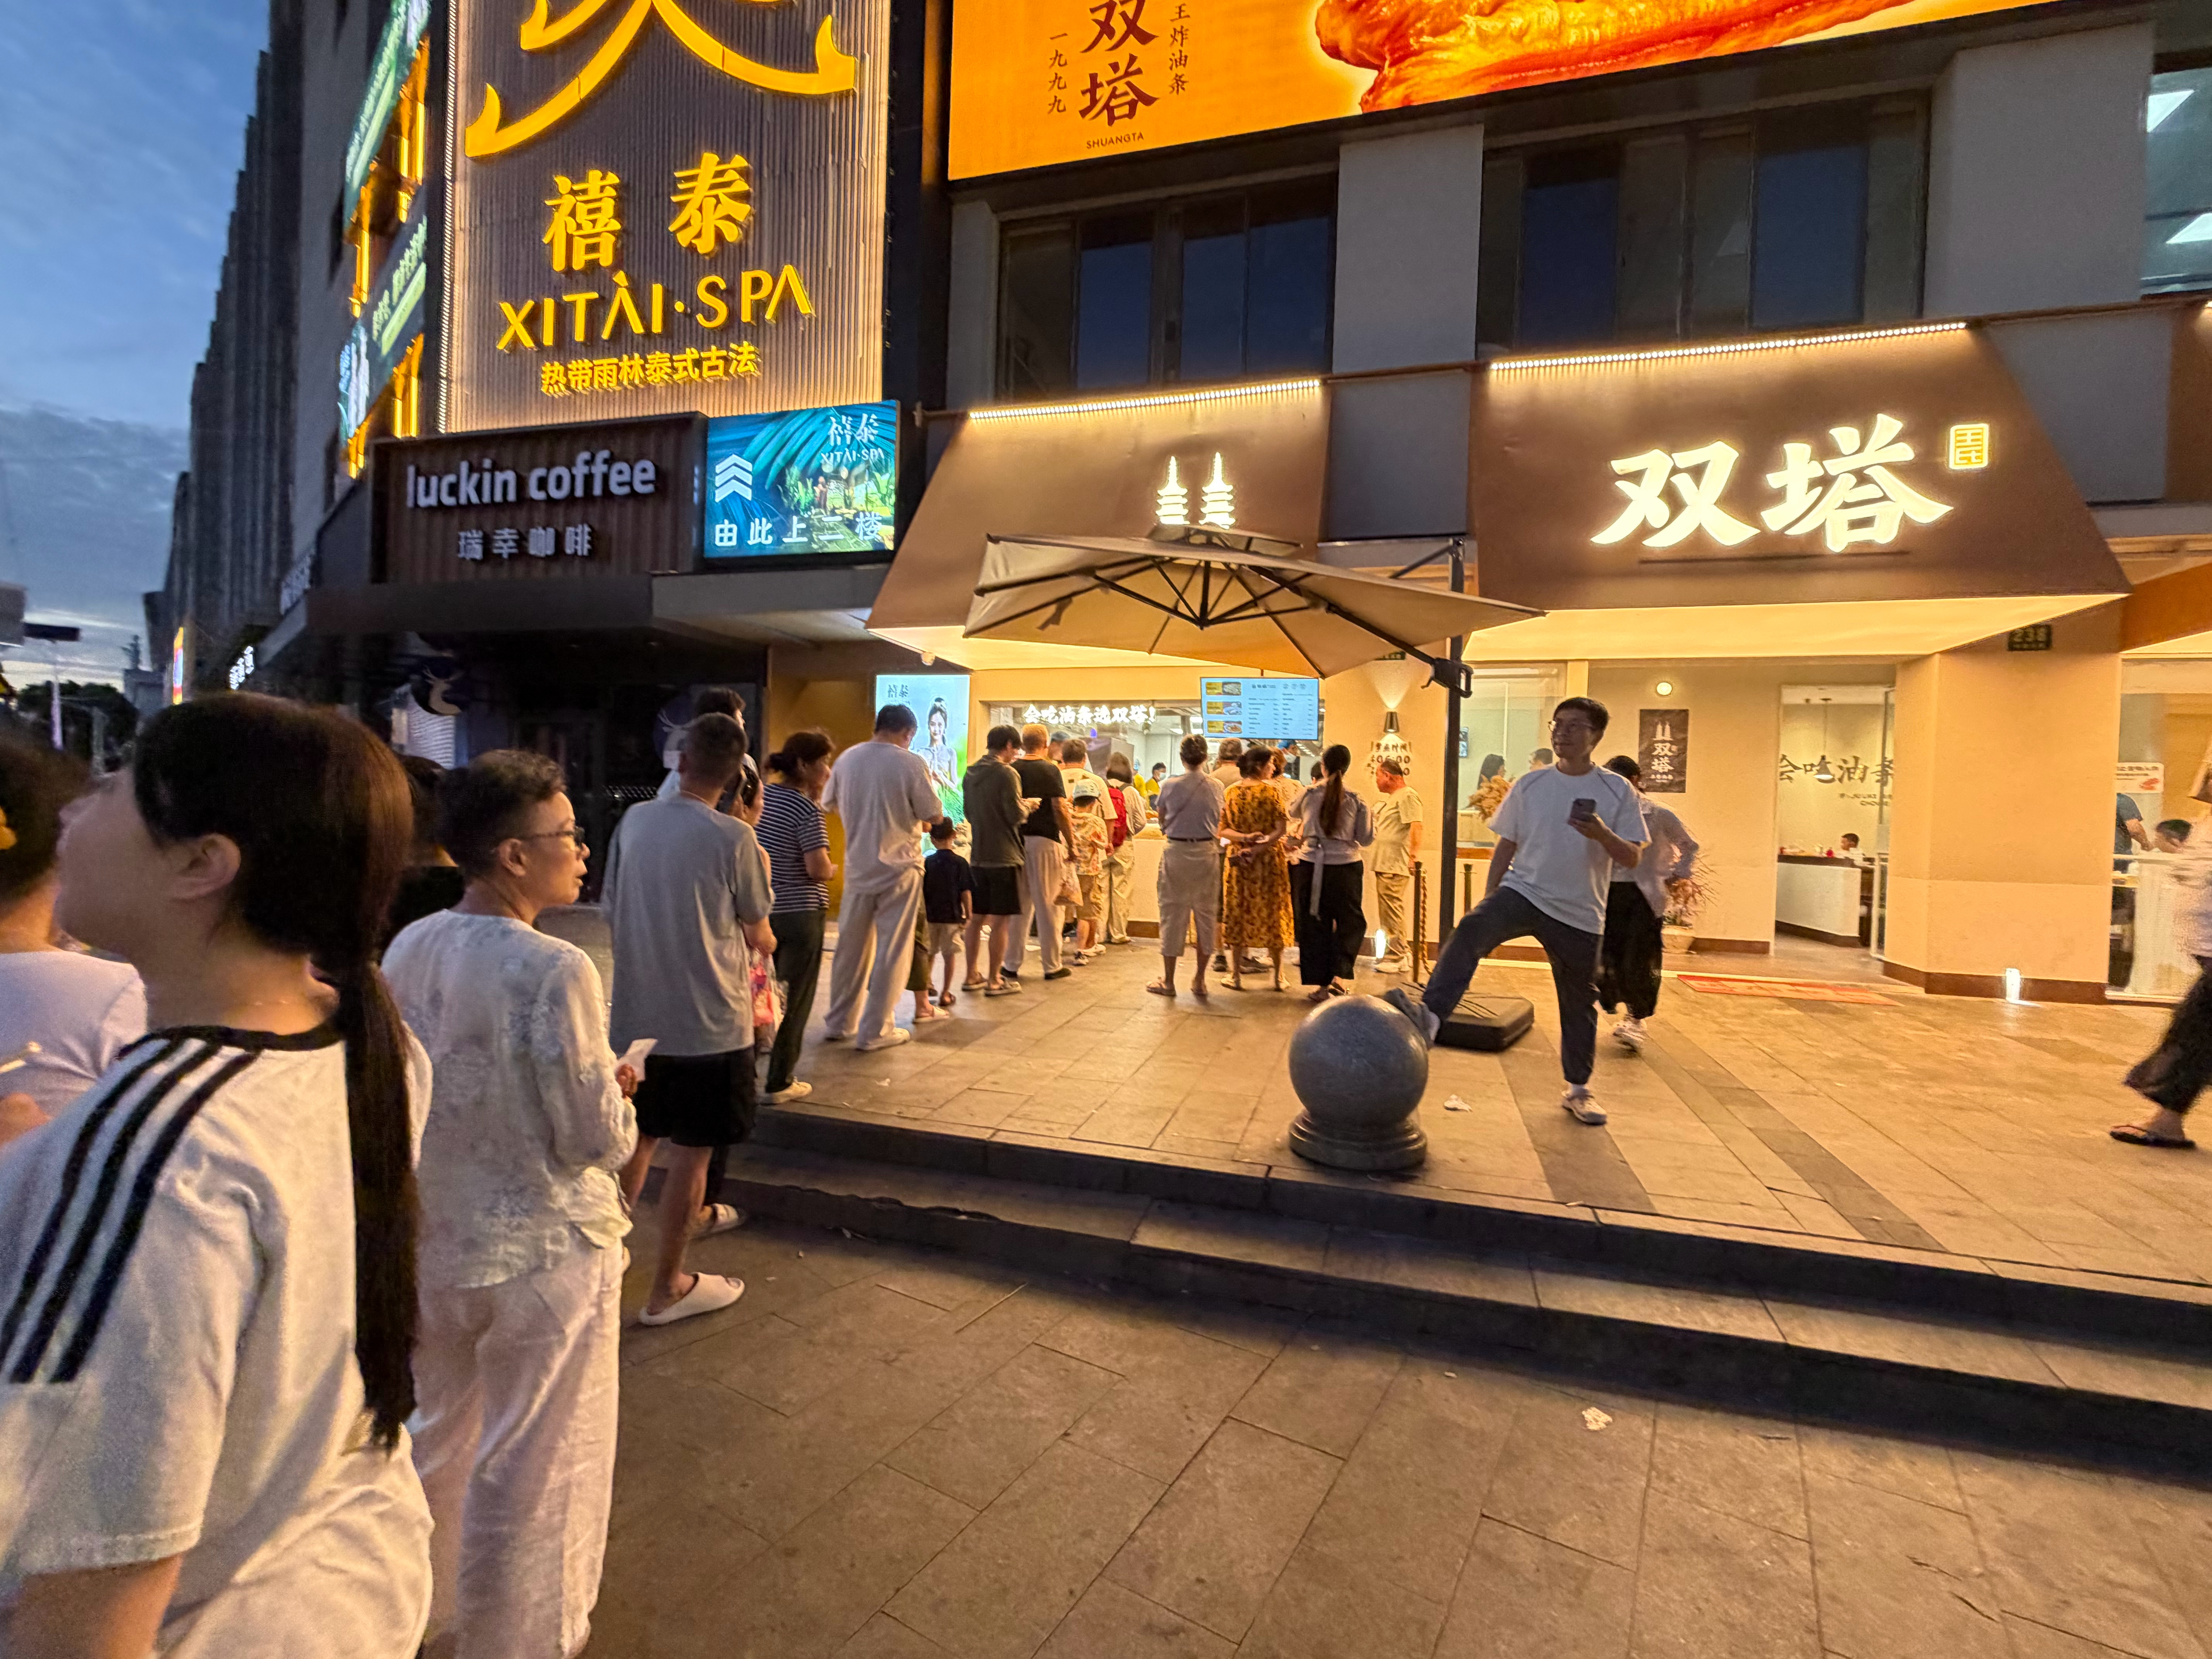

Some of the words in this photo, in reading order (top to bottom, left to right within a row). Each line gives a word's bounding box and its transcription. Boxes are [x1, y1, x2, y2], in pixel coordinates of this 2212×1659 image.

[1048, 33, 1068, 114] 一九九九
[1079, 0, 1160, 127] 双塔
[1169, 3, 1191, 95] 王炸油条
[1086, 131, 1144, 149] SHUANGTA
[542, 152, 752, 271] 禧泰
[541, 340, 761, 397] 热带雨林泰式古法
[407, 458, 517, 508] luckin
[528, 450, 656, 500] coffee
[1590, 413, 1954, 553] 双塔
[458, 524, 592, 560] 瑞幸咖啡
[715, 512, 883, 547] 由此上二楼
